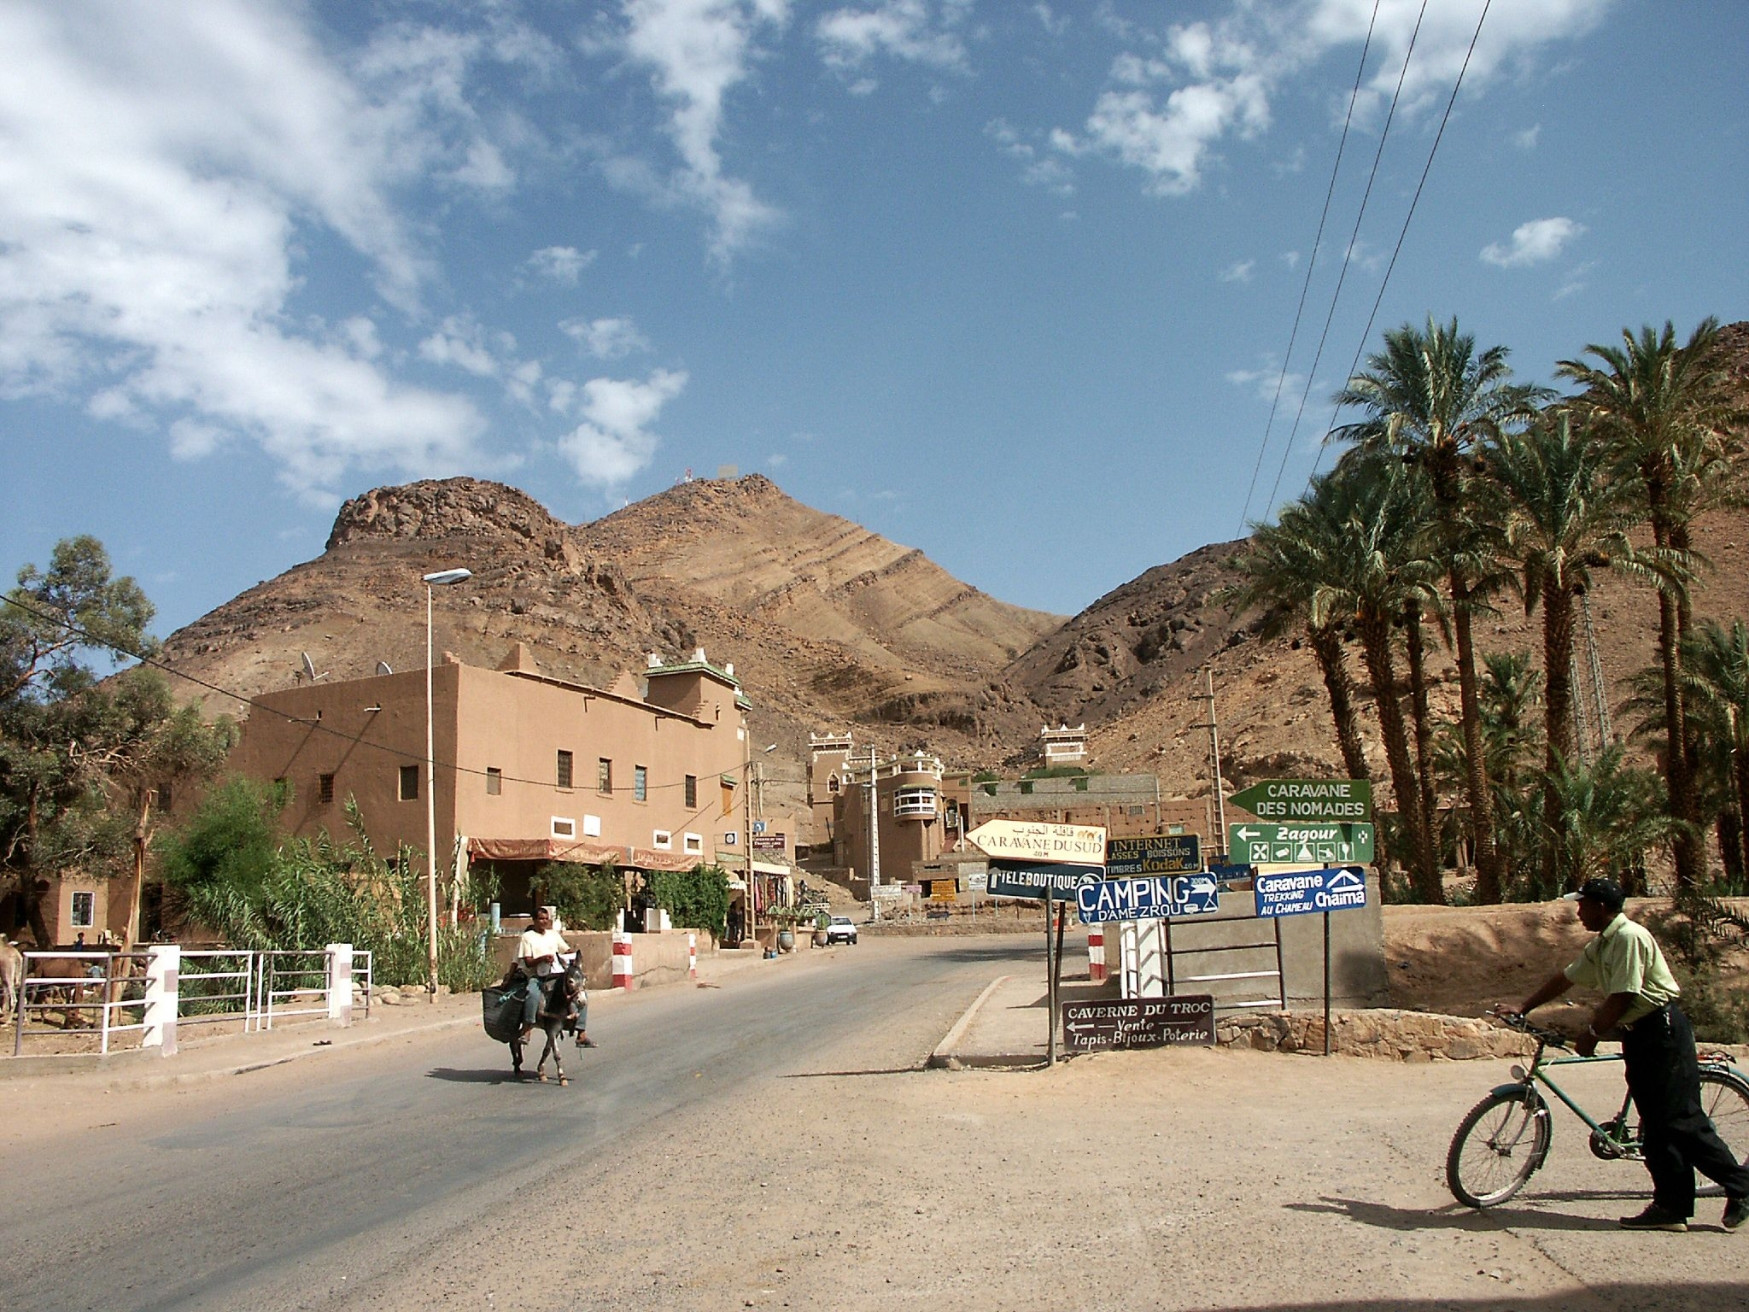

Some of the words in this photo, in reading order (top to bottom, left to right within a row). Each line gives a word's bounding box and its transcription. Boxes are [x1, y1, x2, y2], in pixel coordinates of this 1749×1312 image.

[1267, 784, 1351, 798] CARAVANE
[1257, 801, 1287, 815] DES
[1290, 802, 1365, 816] NOMADES
[1276, 826, 1338, 843] Zagour
[977, 834, 1051, 851] CARAVANE
[1114, 838, 1181, 851] INTERNET
[1146, 848, 1191, 859] BOISSONS
[1106, 864, 1142, 875] TIMBRES
[1079, 877, 1190, 912] CAMPING
[1263, 890, 1305, 903] TREKKING
[1261, 905, 1273, 916] AU
[1275, 901, 1314, 914] CHAMEAU
[1068, 1005, 1139, 1020] CAVERNE
[1144, 1003, 1167, 1016] DU
[1171, 1002, 1211, 1014] TROC
[1117, 1018, 1155, 1032] Vente
